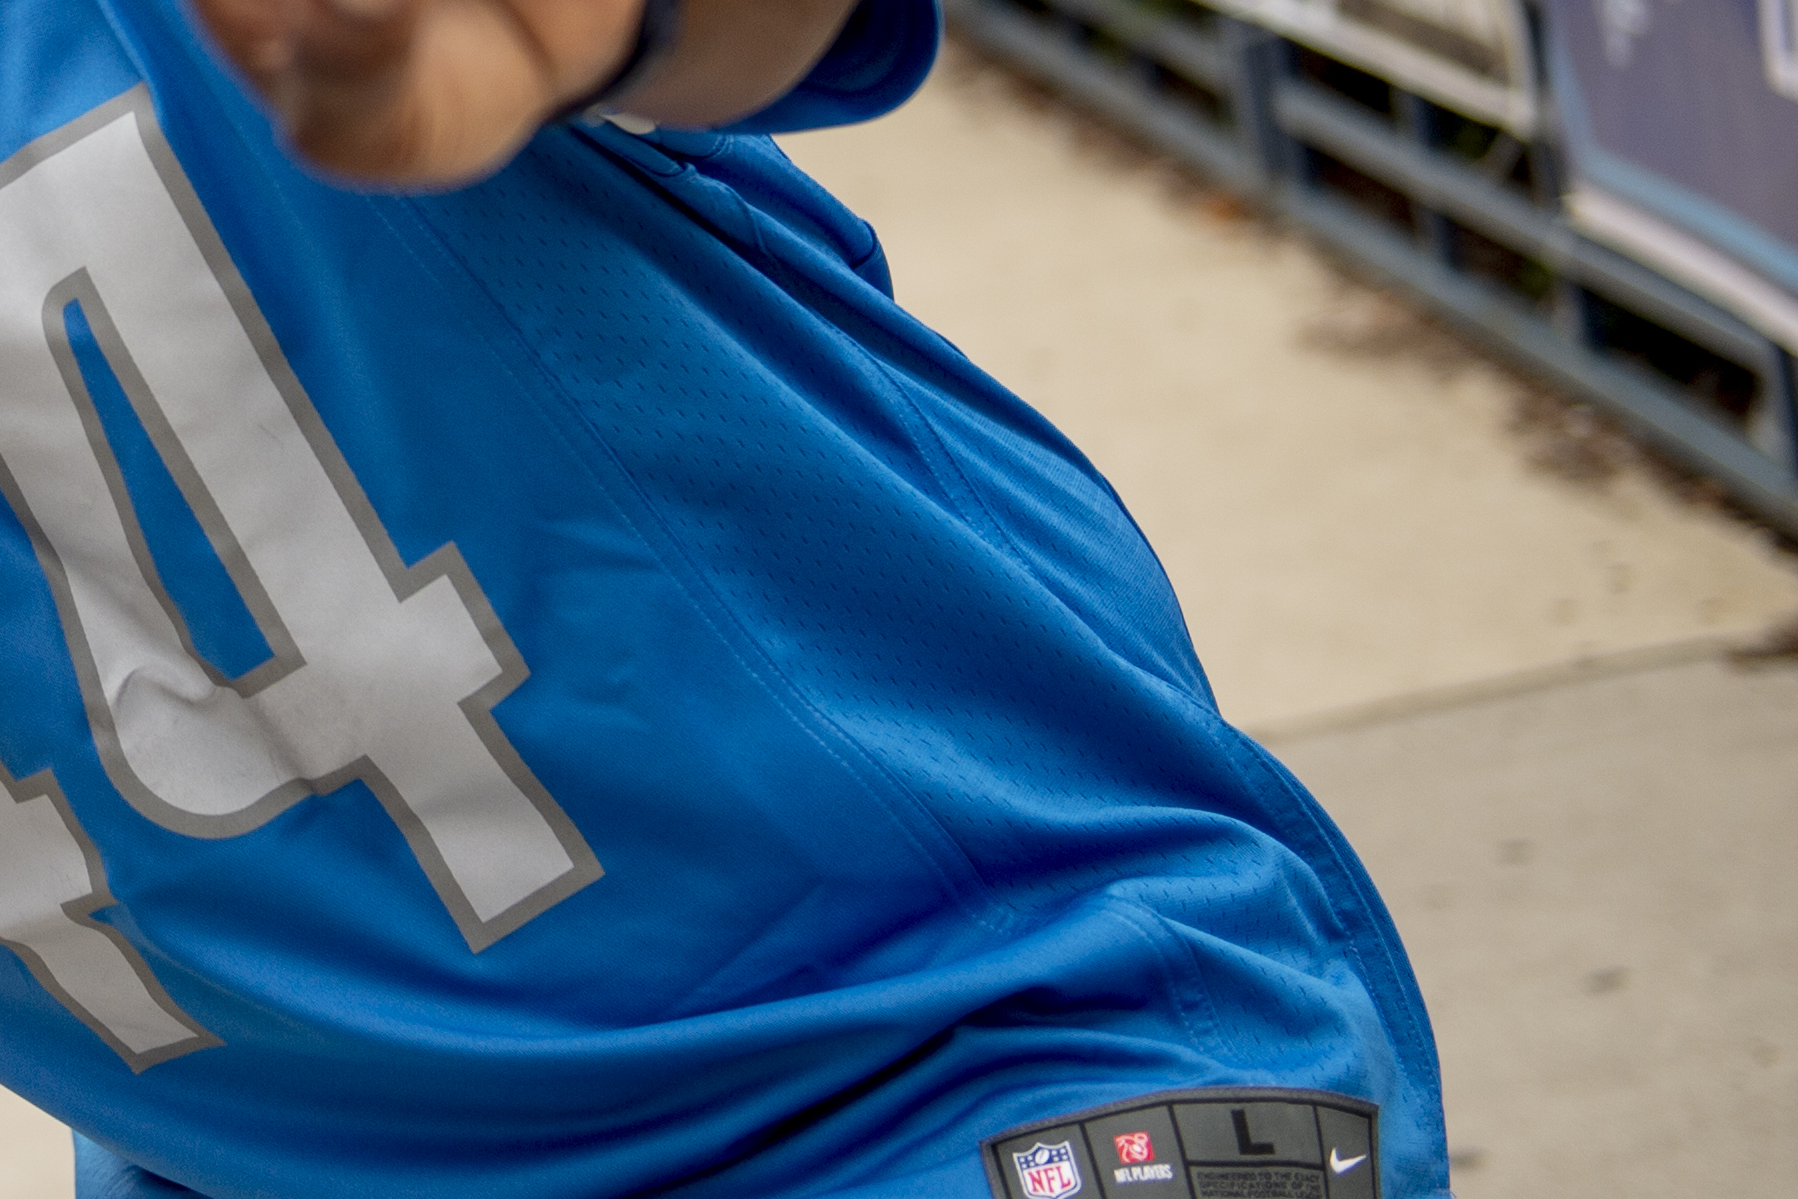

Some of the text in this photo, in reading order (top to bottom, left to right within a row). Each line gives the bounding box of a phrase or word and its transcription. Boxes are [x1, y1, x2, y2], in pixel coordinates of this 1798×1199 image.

[1230, 1108, 1276, 1155] L
[1028, 1164, 1072, 1194] NFL
[1130, 1163, 1173, 1181] PLAYERS
